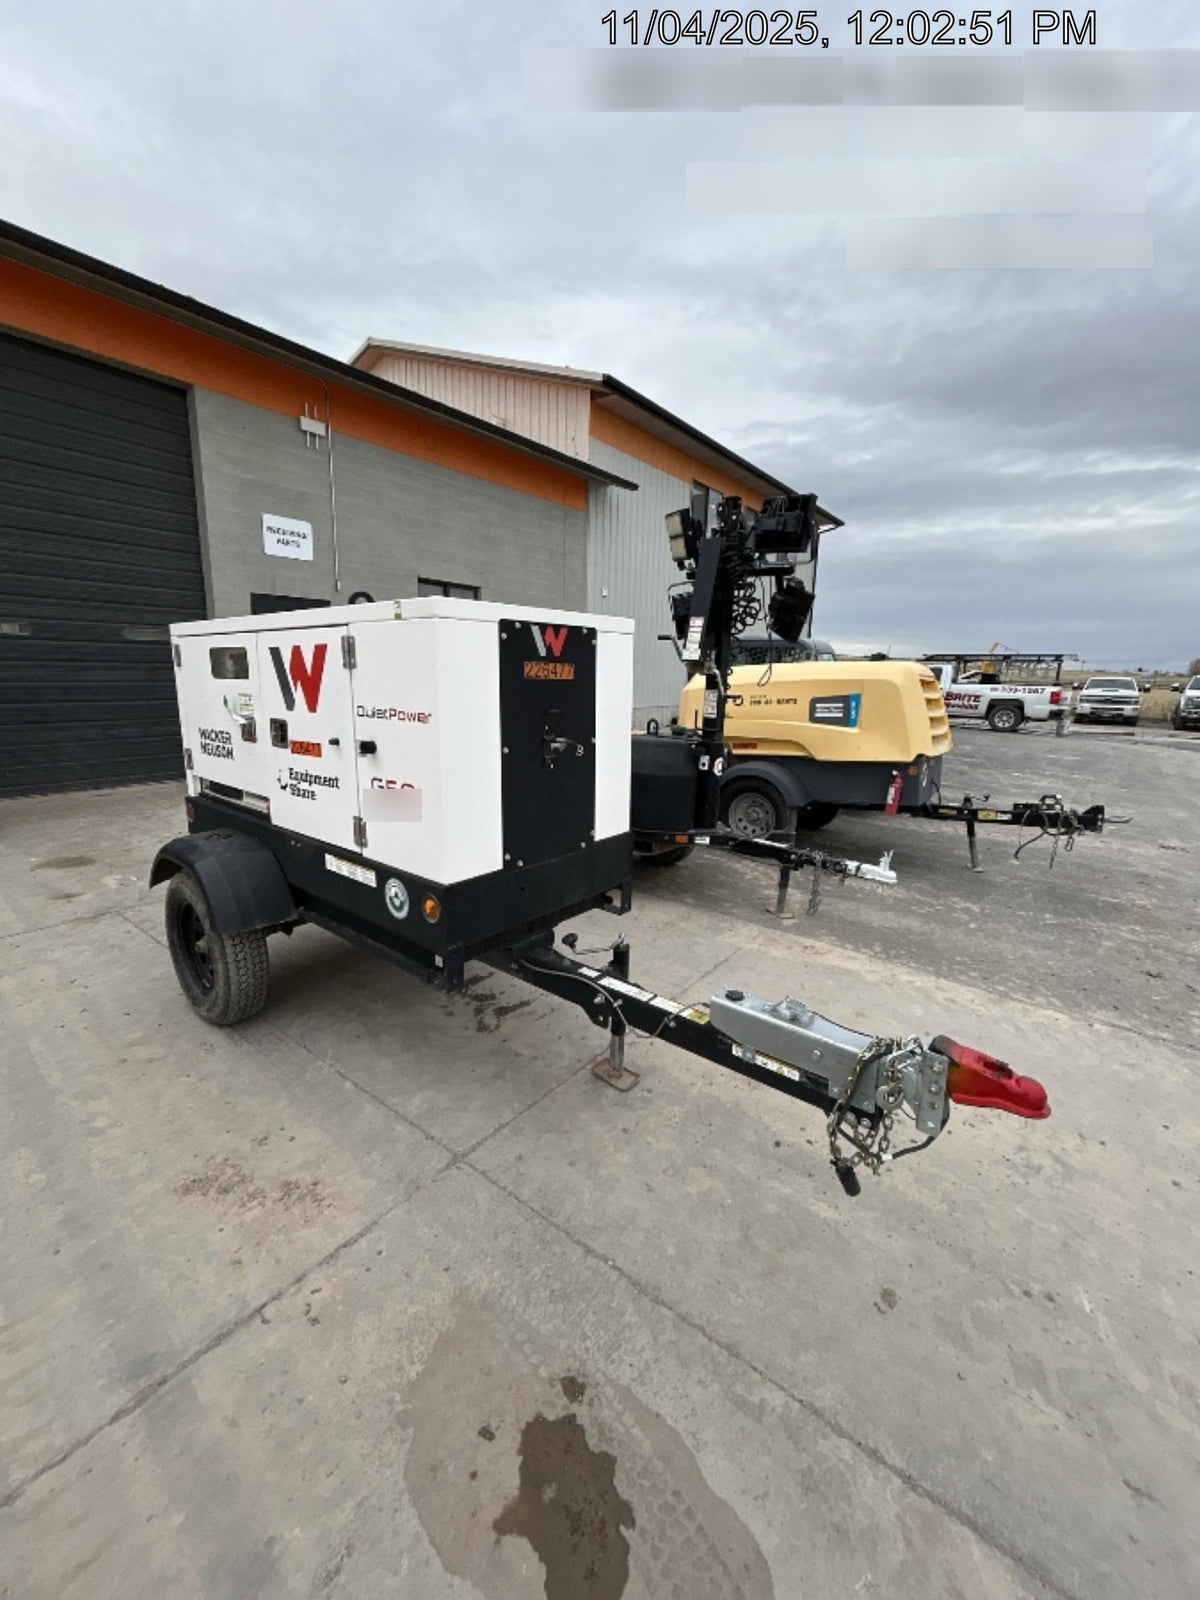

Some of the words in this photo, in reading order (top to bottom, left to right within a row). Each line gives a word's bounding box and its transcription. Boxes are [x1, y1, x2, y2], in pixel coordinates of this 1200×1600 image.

[356, 705, 432, 724] QuietPower
[198, 726, 232, 745] WACKER
[200, 741, 234, 761] NEUSON
[288, 767, 340, 790] Equipment
[289, 783, 317, 801] Share
